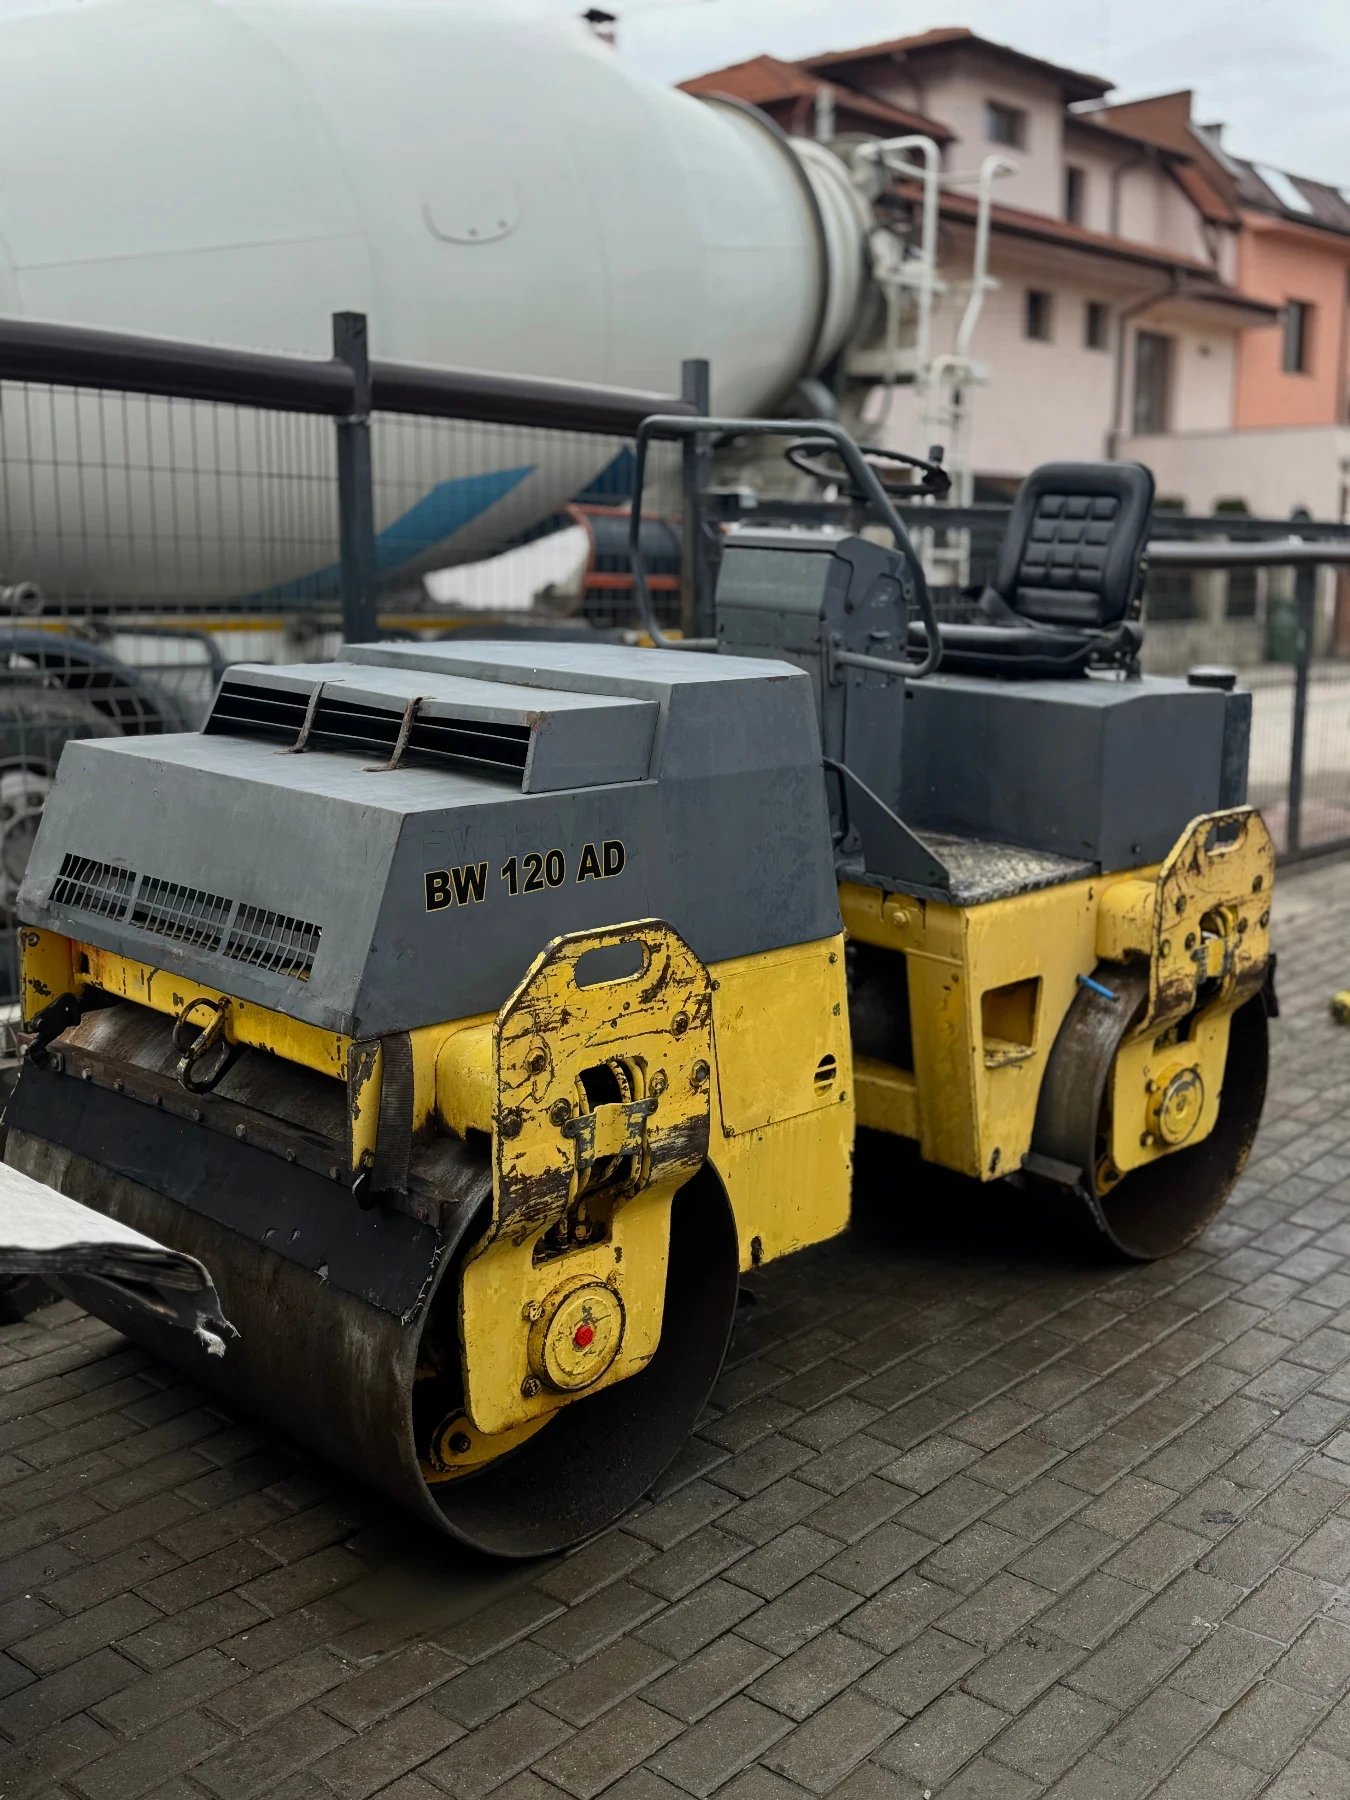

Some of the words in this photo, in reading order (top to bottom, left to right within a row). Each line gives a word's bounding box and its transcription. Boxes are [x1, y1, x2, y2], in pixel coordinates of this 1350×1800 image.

[424, 862, 488, 913] BW
[501, 849, 566, 896] 120
[576, 840, 626, 883] AD
